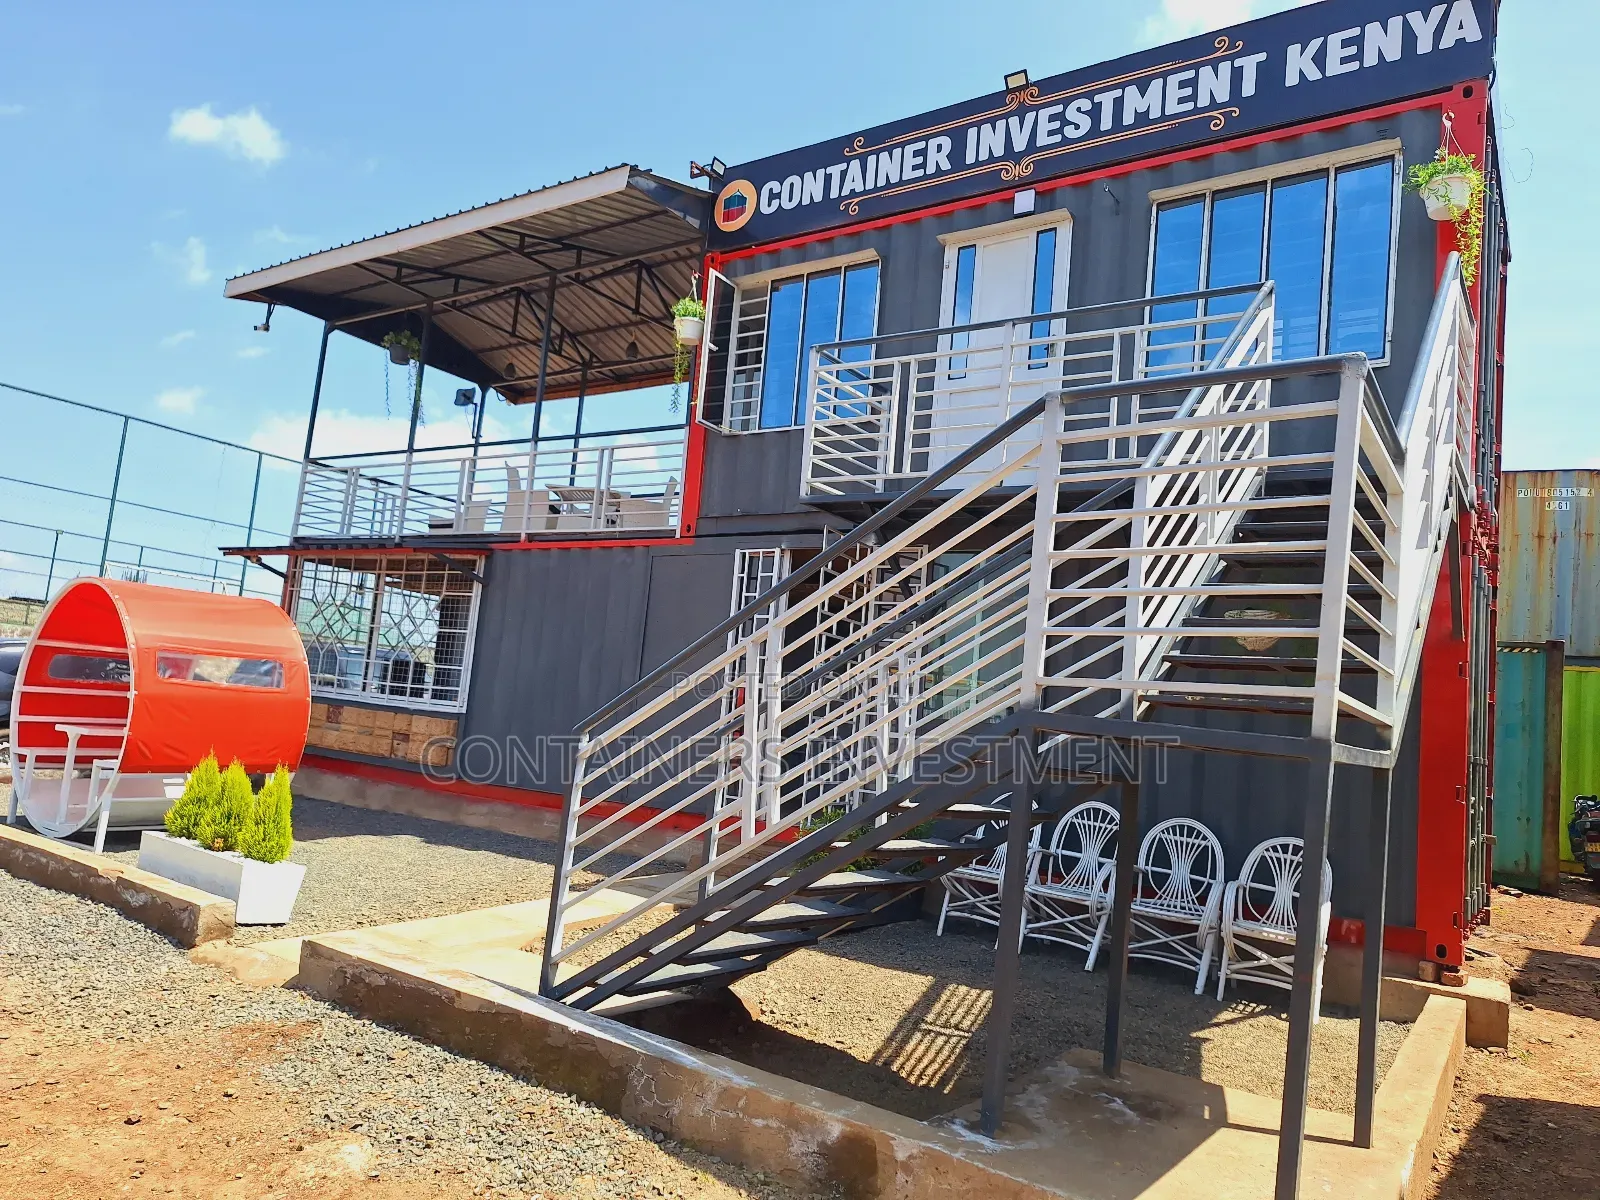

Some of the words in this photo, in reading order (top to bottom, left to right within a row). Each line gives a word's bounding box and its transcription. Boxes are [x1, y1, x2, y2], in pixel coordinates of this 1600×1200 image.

[759, 135, 952, 215] CONTAINER
[964, 51, 1268, 165] INVESTMENT
[1285, 0, 1483, 88] KENYA
